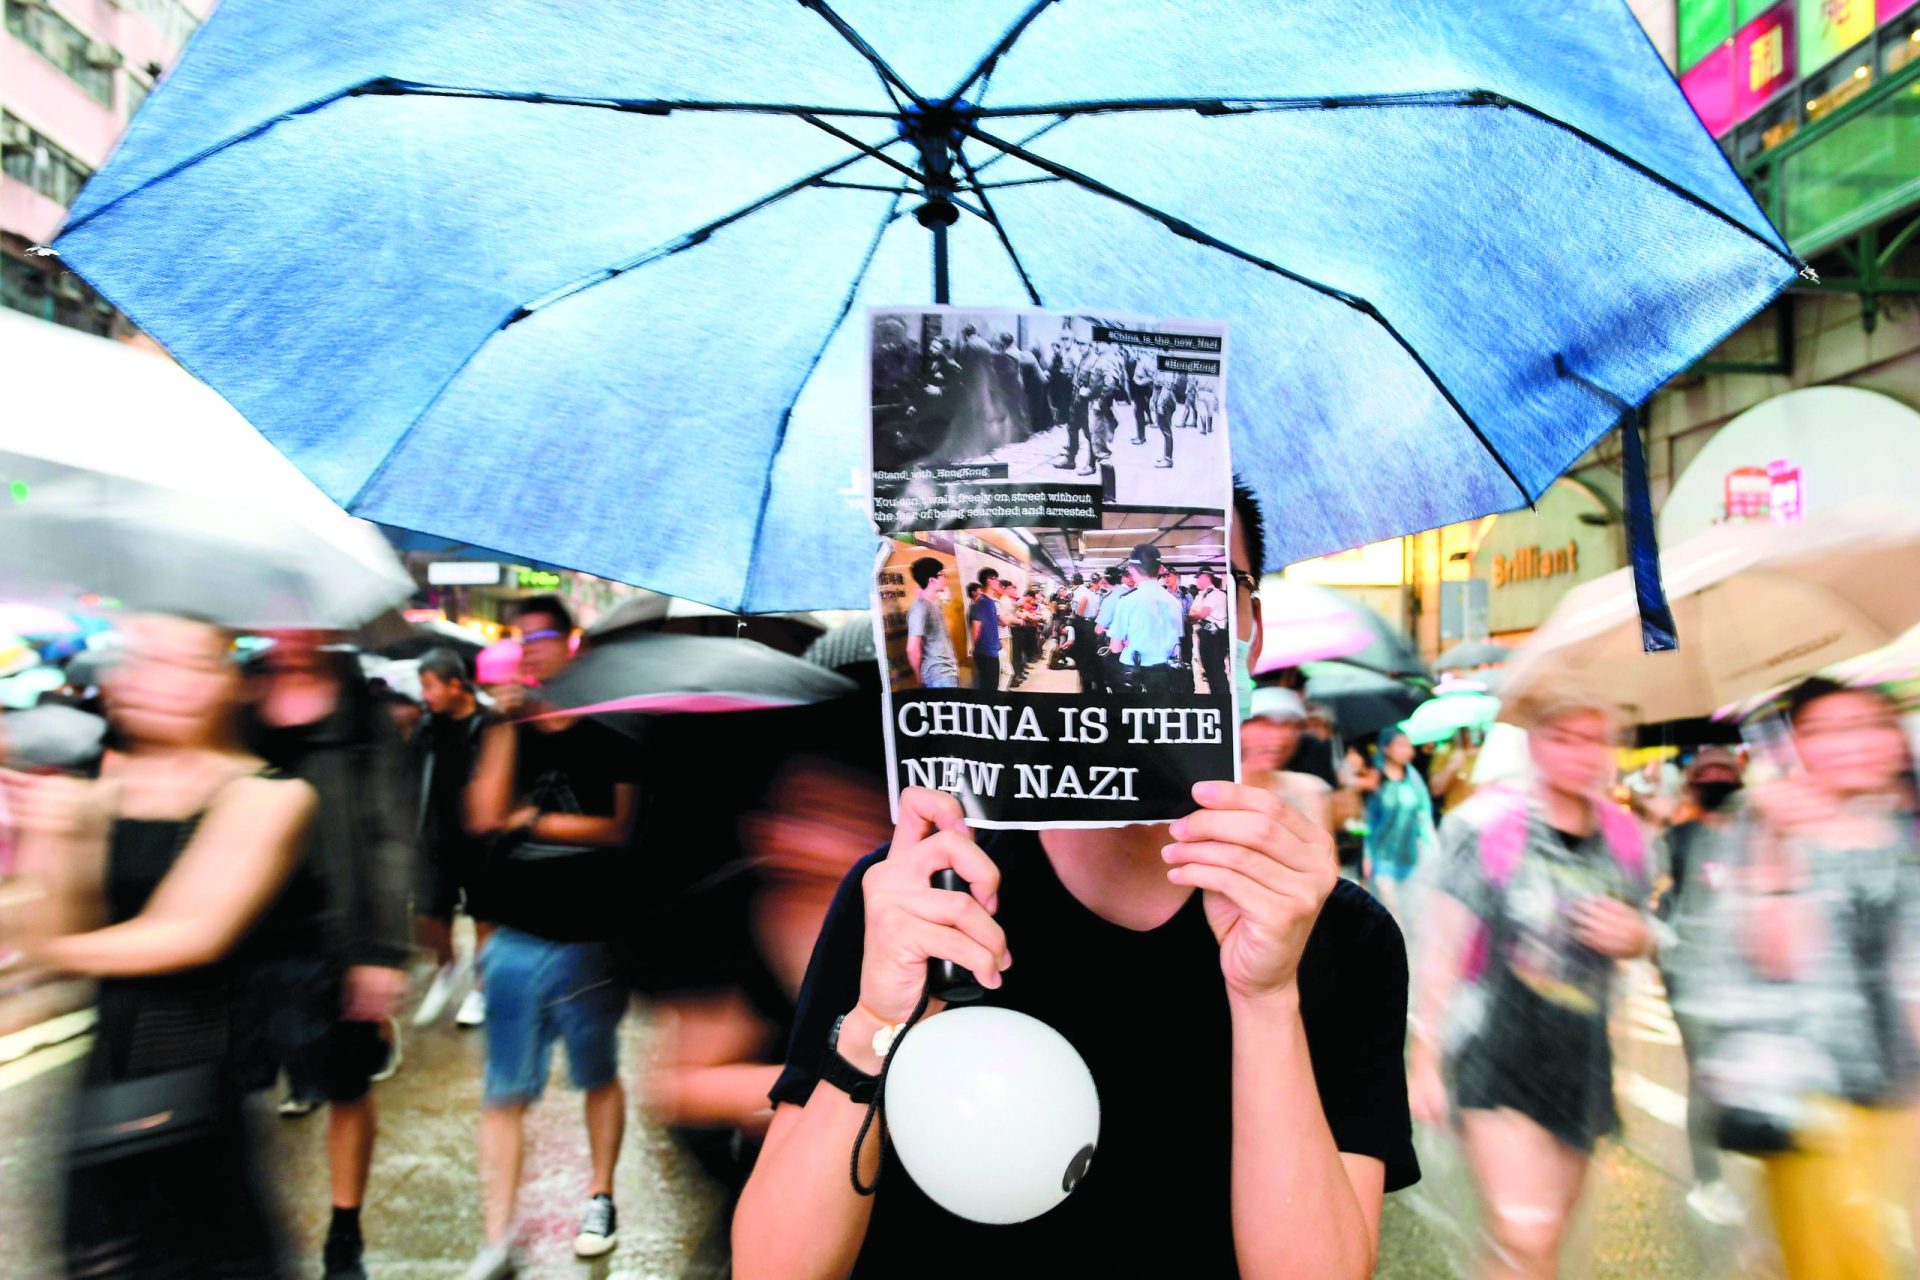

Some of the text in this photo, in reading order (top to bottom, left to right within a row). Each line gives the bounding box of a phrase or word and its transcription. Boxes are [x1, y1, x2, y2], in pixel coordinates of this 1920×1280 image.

[1164, 360, 1217, 374] #HongKong
[874, 497, 897, 508] You
[928, 494, 956, 505] walk
[957, 492, 991, 504] freely
[994, 493, 1010, 502] on
[1011, 491, 1045, 502] street
[1047, 492, 1093, 503] without
[874, 505, 1097, 521] the fear of being searched and arrested.
[899, 701, 1222, 744] CHINA IS THE
[901, 757, 1140, 801] NEW NAZI
